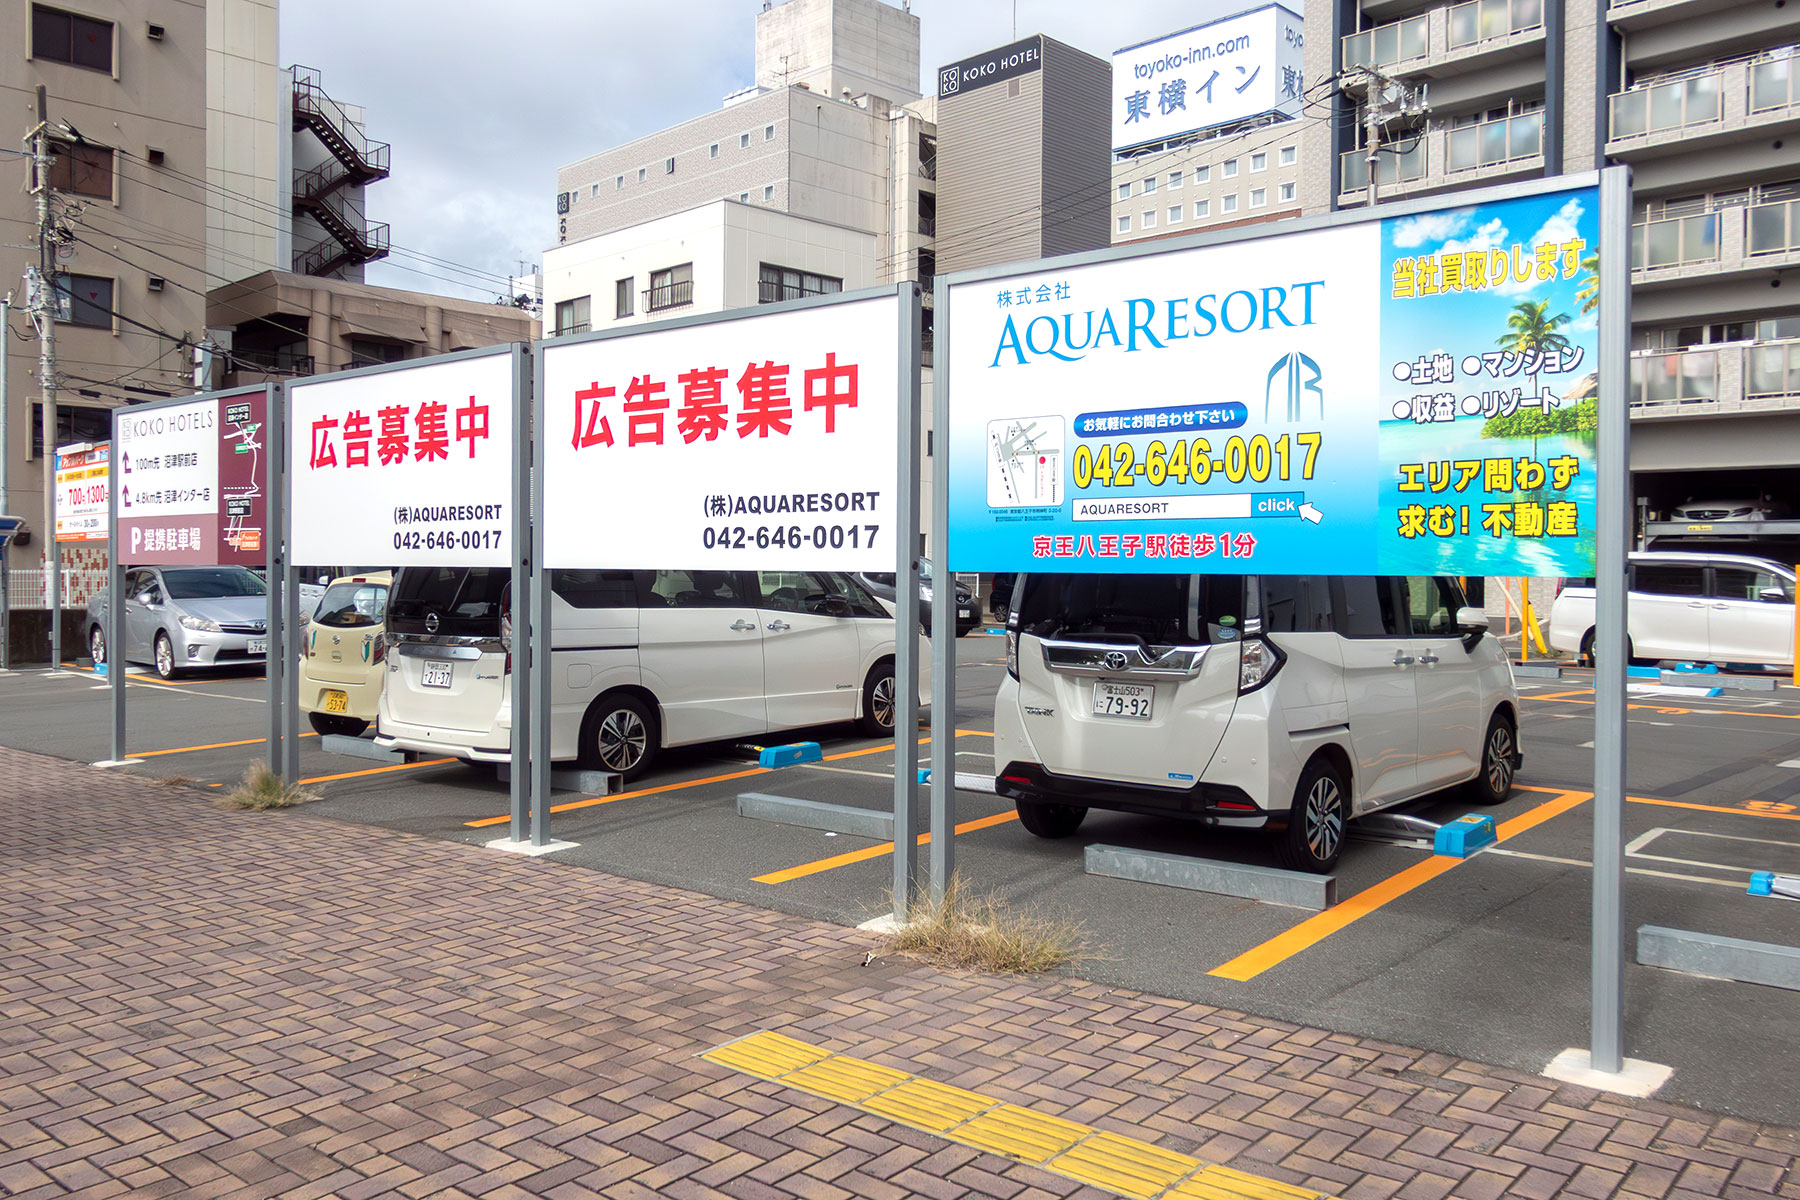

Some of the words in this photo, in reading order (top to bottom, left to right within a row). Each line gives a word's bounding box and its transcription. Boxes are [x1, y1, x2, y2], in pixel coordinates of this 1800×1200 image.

[963, 61, 996, 82] KOKO
[1001, 48, 1039, 70] HOTEL
[1135, 34, 1250, 79] toyoko-inn.com
[1124, 65, 1261, 125] 東横イン
[1393, 237, 1585, 298] 当社買取りします
[997, 281, 1071, 308] 株式会社
[988, 280, 1325, 368] AQUARESORT
[1411, 354, 1454, 385] 土地
[1482, 346, 1585, 378] マンション
[571, 352, 859, 451] 広告募集中
[1411, 393, 1455, 424] 収益
[1482, 387, 1561, 418] リゾート
[134, 418, 164, 437] KOKO
[169, 410, 213, 432] HOTELS
[309, 395, 490, 471] 広告募集中
[1083, 409, 1235, 433] お気軽にお問合わせ下さい
[136, 457, 160, 470] 100m先
[164, 452, 198, 469] 沼津駅前店
[1073, 432, 1322, 488] 042-646-0017
[1398, 454, 1580, 493] エリア問わず
[136, 490, 162, 504] 4.8km先
[164, 488, 210, 503] 沼津インター店
[704, 491, 880, 517] (株)AQUARESORT
[1080, 503, 1169, 516] AQUARESORT
[1258, 498, 1296, 512] click
[394, 504, 502, 524] (株)AQUARESORT
[1398, 503, 1470, 539] 求む!
[1482, 500, 1578, 539] 不動産
[144, 527, 201, 551] 提携駐車場
[394, 530, 502, 550] 042-646-0017
[703, 525, 880, 549] 042-646-0017
[1032, 532, 1257, 558] 京王八王子駅徒歩1分
[428, 671, 450, 684] 21-37
[1106, 696, 1149, 717] 79-92
